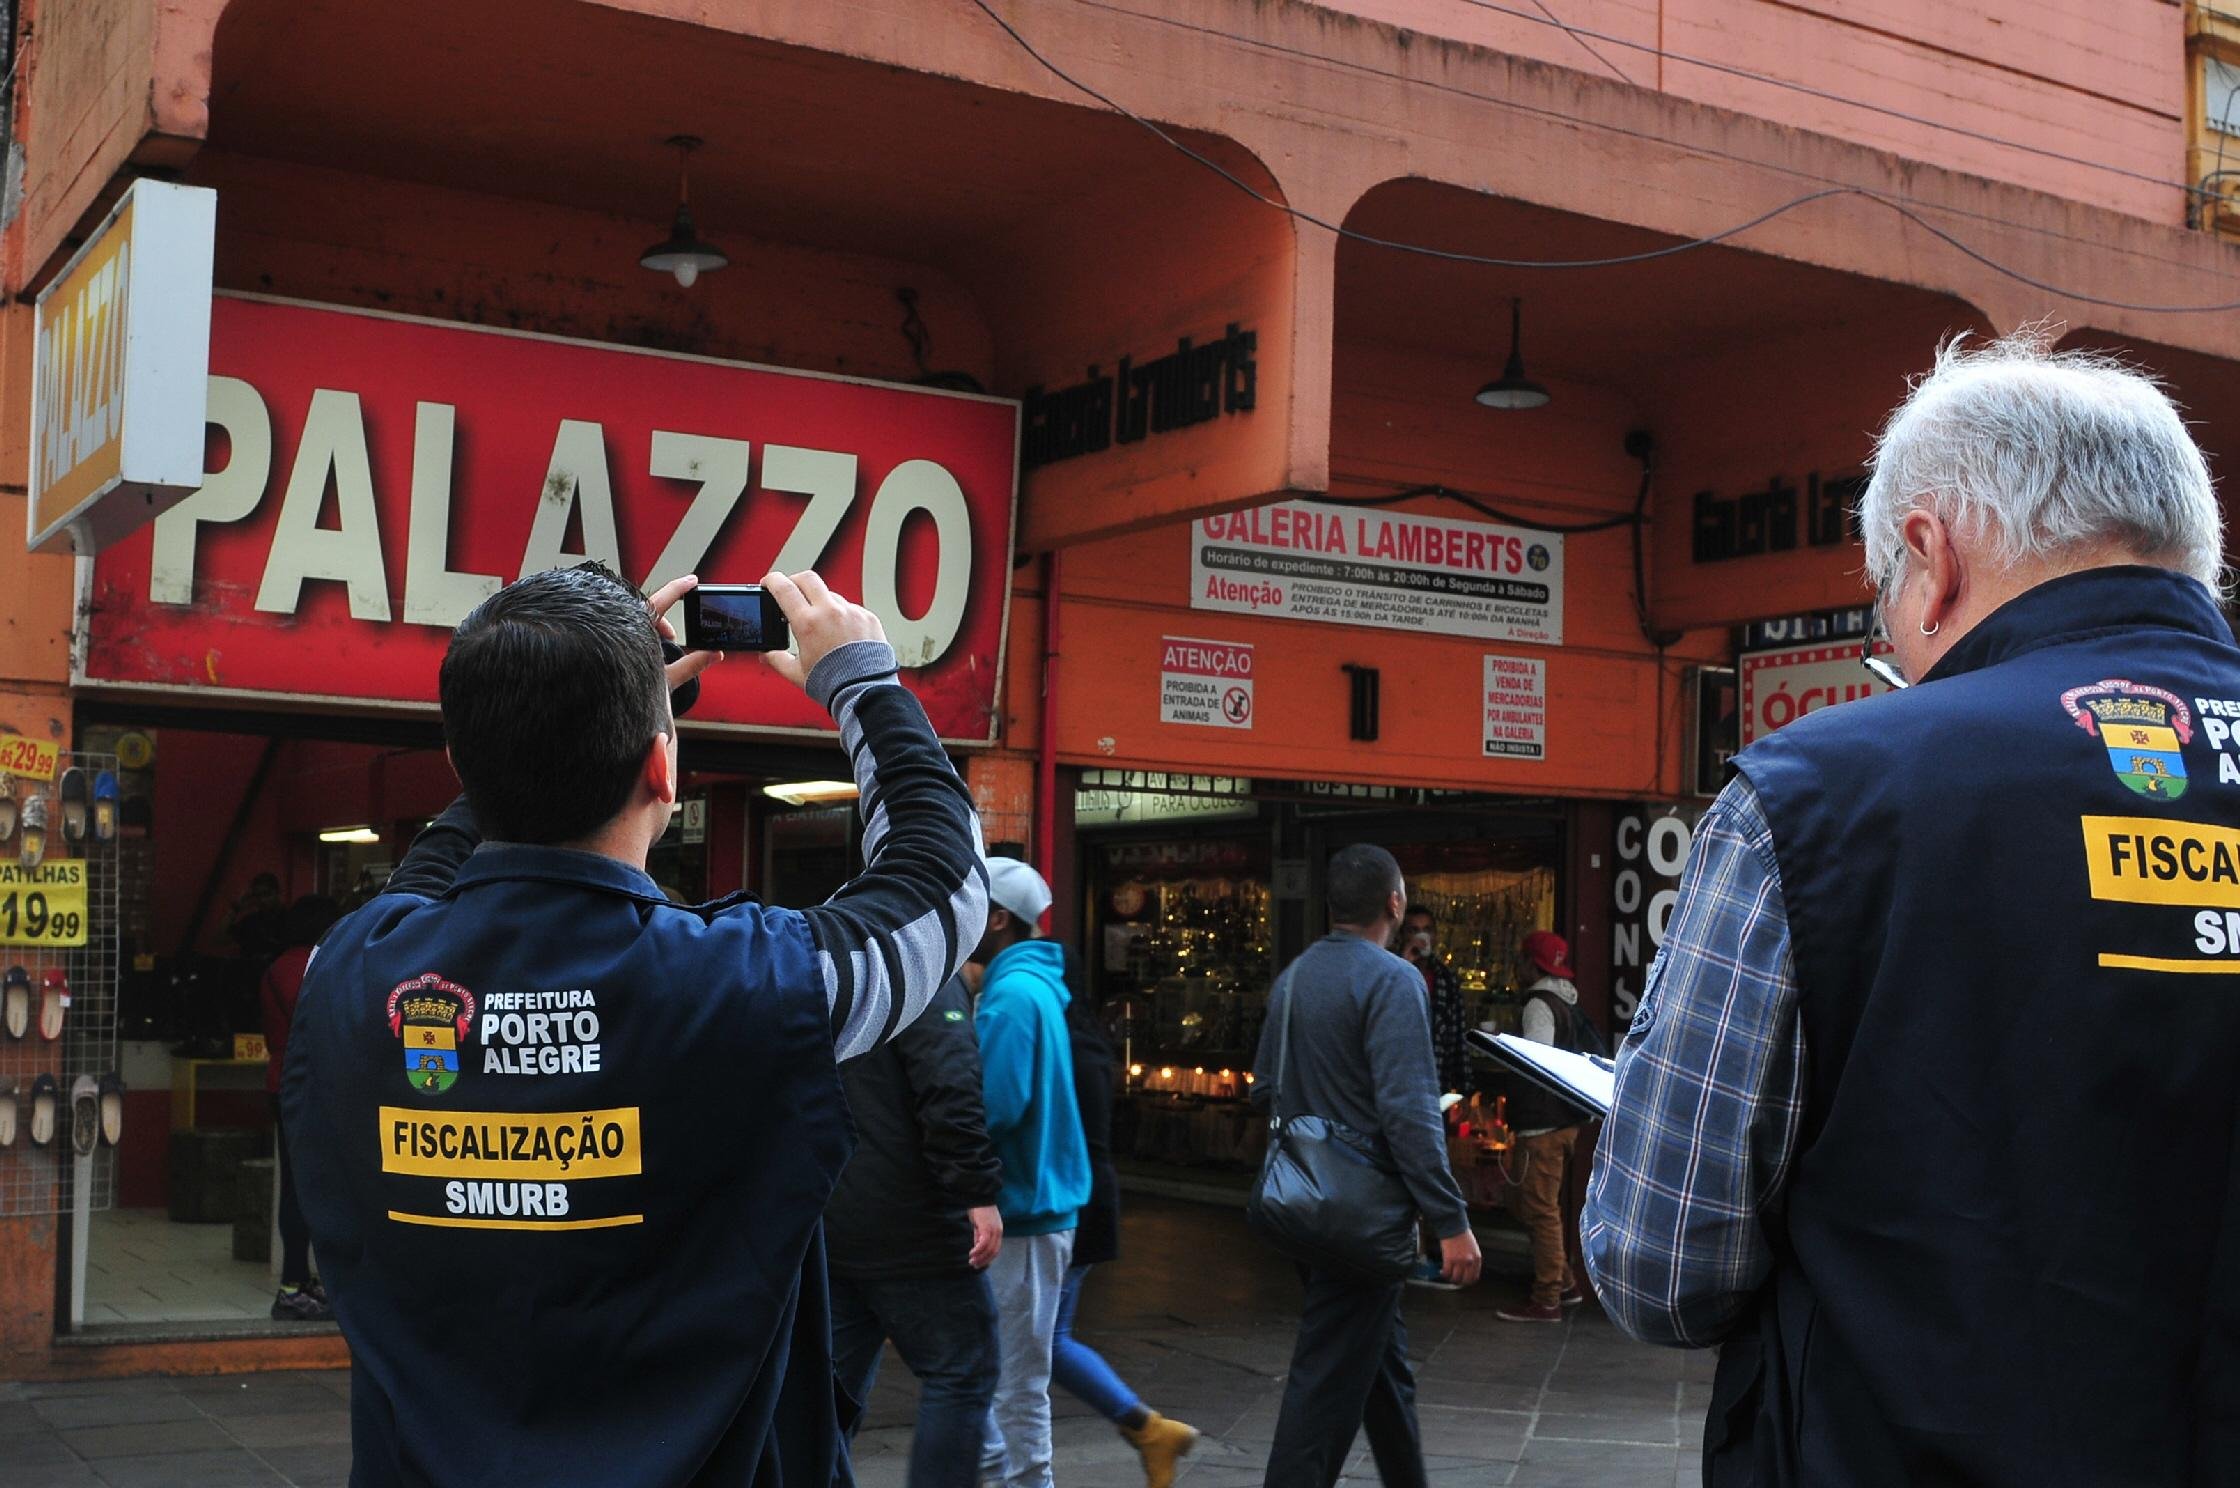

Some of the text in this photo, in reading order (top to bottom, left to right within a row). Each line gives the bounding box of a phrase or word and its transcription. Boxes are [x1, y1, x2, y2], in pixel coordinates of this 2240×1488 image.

[36, 240, 128, 499] PALAZZO
[150, 373, 972, 668] PALAZZO
[1202, 507, 1523, 575] GALERIA LAMBERTS
[1207, 551, 1251, 566] Horário
[1254, 556, 1268, 569] de
[1271, 559, 1335, 576] expediente
[1344, 566, 1375, 580] 7:00h
[1394, 571, 1430, 586] 20:00h
[1433, 576, 1447, 588] de
[1449, 578, 1496, 594] Segunda
[1206, 575, 1283, 609] Atenção
[1291, 582, 1342, 596] PROIBIDO
[1345, 588, 1353, 597] O
[1409, 595, 1422, 605] DE
[1291, 594, 1341, 607] ENTREGA
[1343, 599, 1358, 609] DE
[1164, 646, 1251, 675] ATENÇÃO
[1530, 664, 1537, 676] A
[1166, 680, 1217, 695] PROIBIDA A
[1523, 678, 1534, 692] DE
[1163, 694, 1220, 709] ENTRADA DE
[1172, 709, 1210, 722] ANIMAIS
[2195, 697, 2240, 718] PRE
[2108, 833, 2240, 885] FISCA
[0, 865, 80, 883] ATILHAS
[484, 990, 596, 1010] PREFEITURA
[480, 1011, 600, 1045] PORTO
[483, 1044, 601, 1075] ALEGRE
[394, 1115, 625, 1171] FISCALIZAÇÃO
[445, 1180, 570, 1216] SMURB
